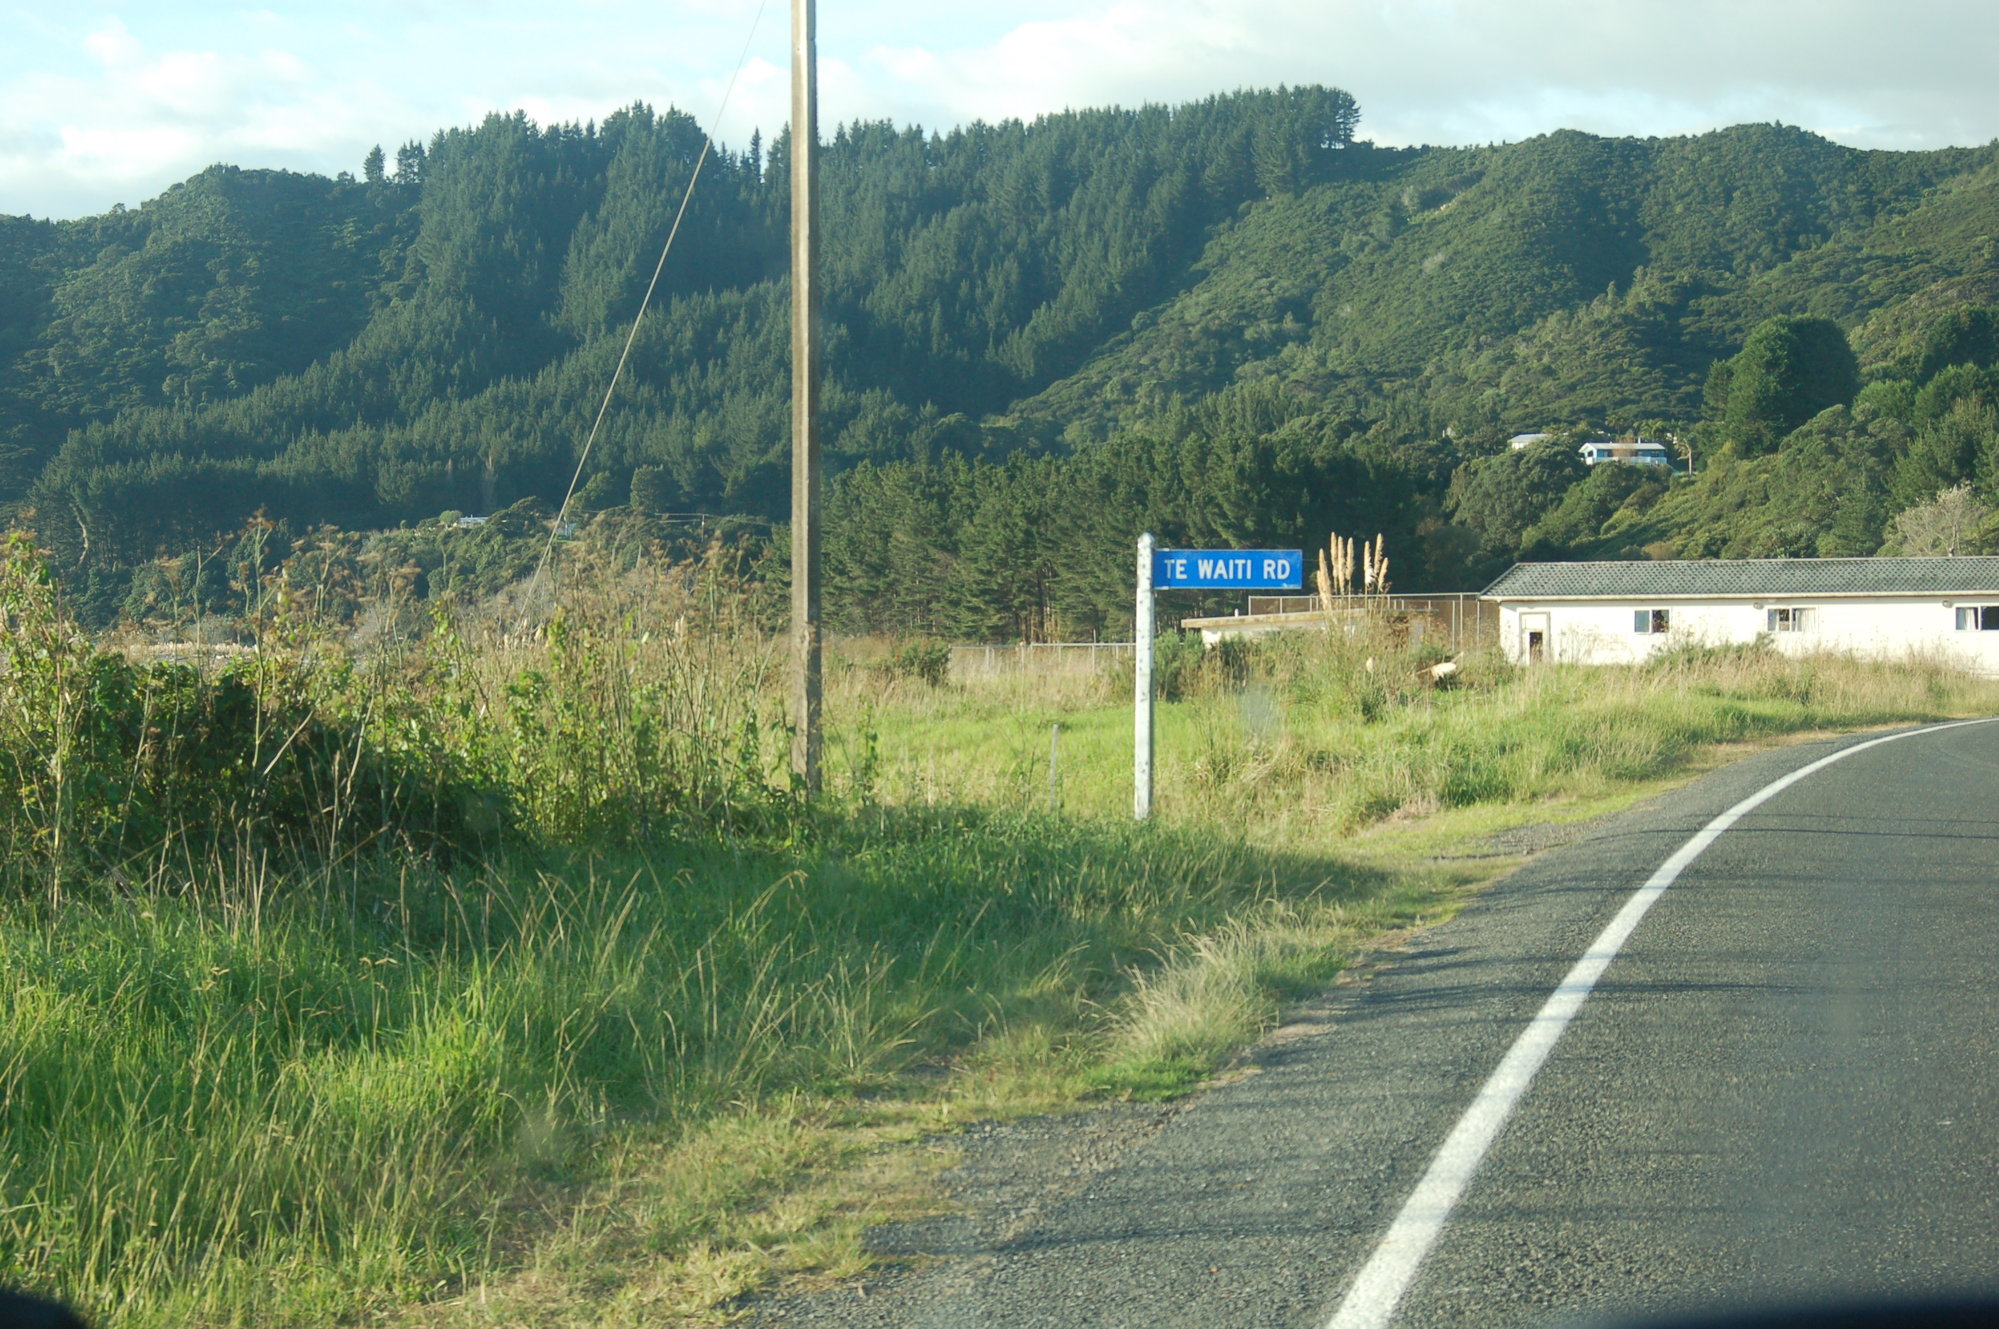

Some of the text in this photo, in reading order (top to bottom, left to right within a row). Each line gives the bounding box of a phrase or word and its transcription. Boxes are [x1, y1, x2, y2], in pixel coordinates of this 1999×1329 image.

[1164, 559, 1290, 579] TE WAITI RD
